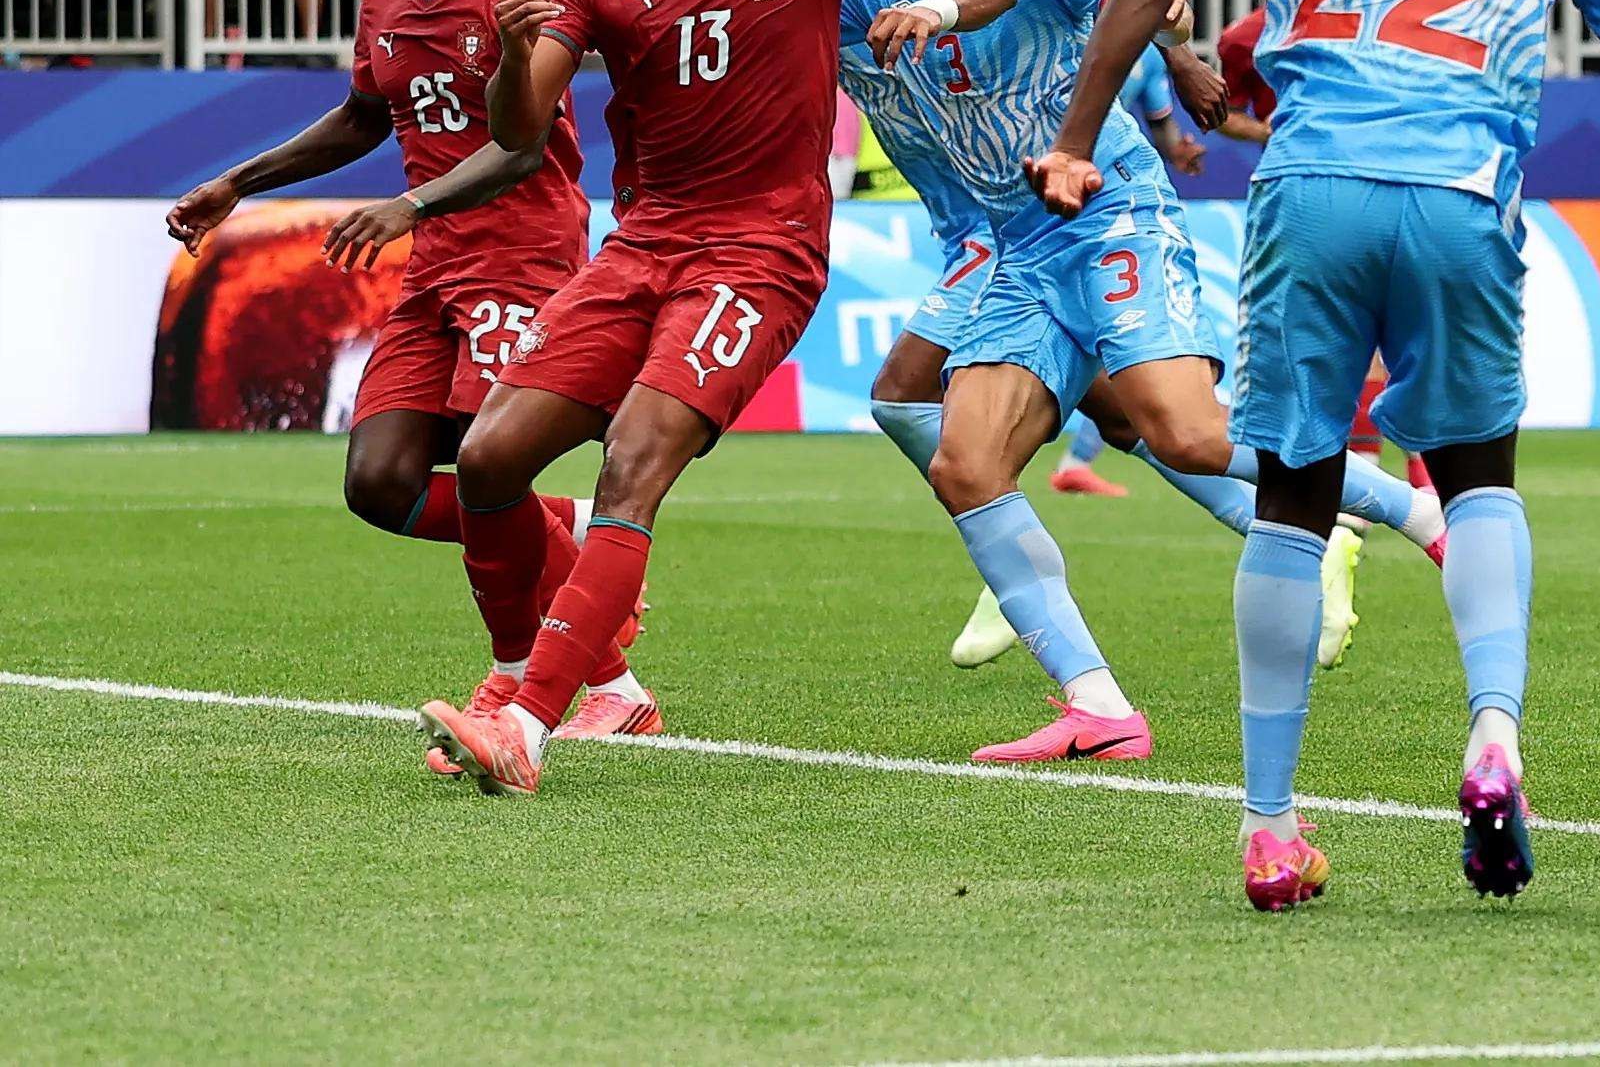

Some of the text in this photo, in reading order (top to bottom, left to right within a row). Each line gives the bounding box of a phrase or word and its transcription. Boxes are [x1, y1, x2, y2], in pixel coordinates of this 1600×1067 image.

[674, 8, 731, 85] 13
[935, 34, 972, 94] 3
[409, 72, 469, 133] 25
[943, 240, 992, 289] 7
[1099, 249, 1141, 303] 3
[469, 299, 536, 366] 25
[691, 283, 763, 368] 13
